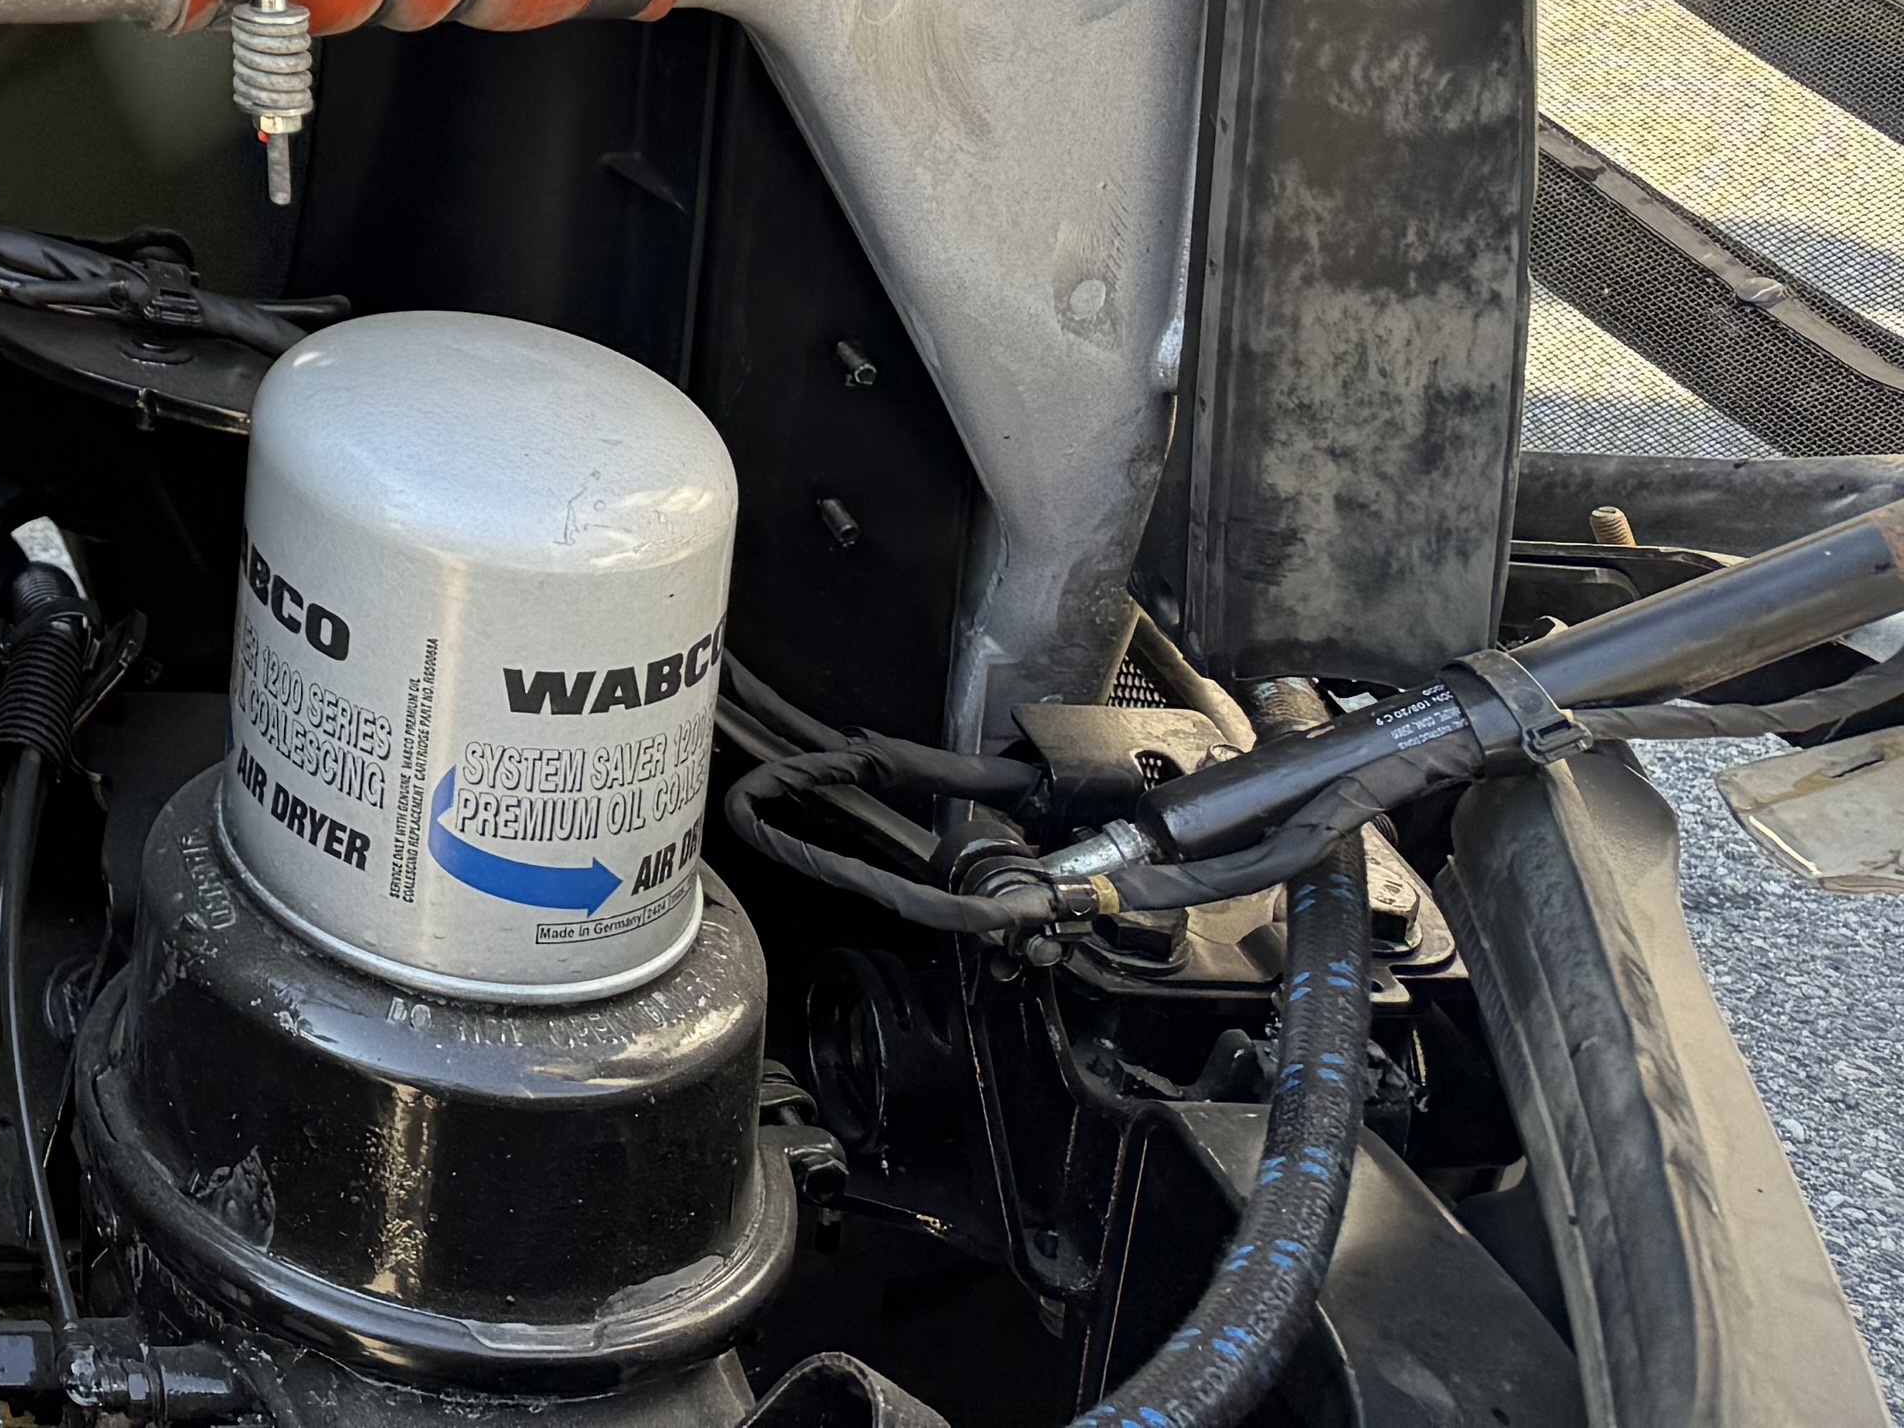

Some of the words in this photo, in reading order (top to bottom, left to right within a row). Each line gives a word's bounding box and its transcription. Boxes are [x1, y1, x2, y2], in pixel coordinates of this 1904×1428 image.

[243, 529, 350, 661] BCO
[502, 611, 728, 716] WABCO
[262, 645, 303, 715] 1200
[307, 682, 393, 761] SERIES
[405, 693, 419, 737] PREMIUM
[422, 703, 432, 727] PART
[250, 679, 386, 810] COALESCING
[402, 737, 415, 770] WABCO
[415, 728, 428, 781] CARTRIDGE
[463, 741, 585, 793] SYSTEM
[591, 732, 667, 790] SAVER
[237, 744, 268, 807] AIR
[270, 781, 372, 872] DRYER
[398, 774, 411, 813] GENUINE
[409, 785, 425, 848] REPLACEMENT
[456, 788, 600, 842] PREMIUM
[606, 787, 646, 835] OIL
[393, 838, 405, 862] ONLY
[396, 813, 408, 837] WITH
[389, 863, 402, 899] SERVICE
[630, 842, 677, 896] AIR
[678, 816, 703, 871] DR
[540, 927, 575, 940] Made
[578, 925, 590, 937] in
[593, 914, 643, 935] Germany
